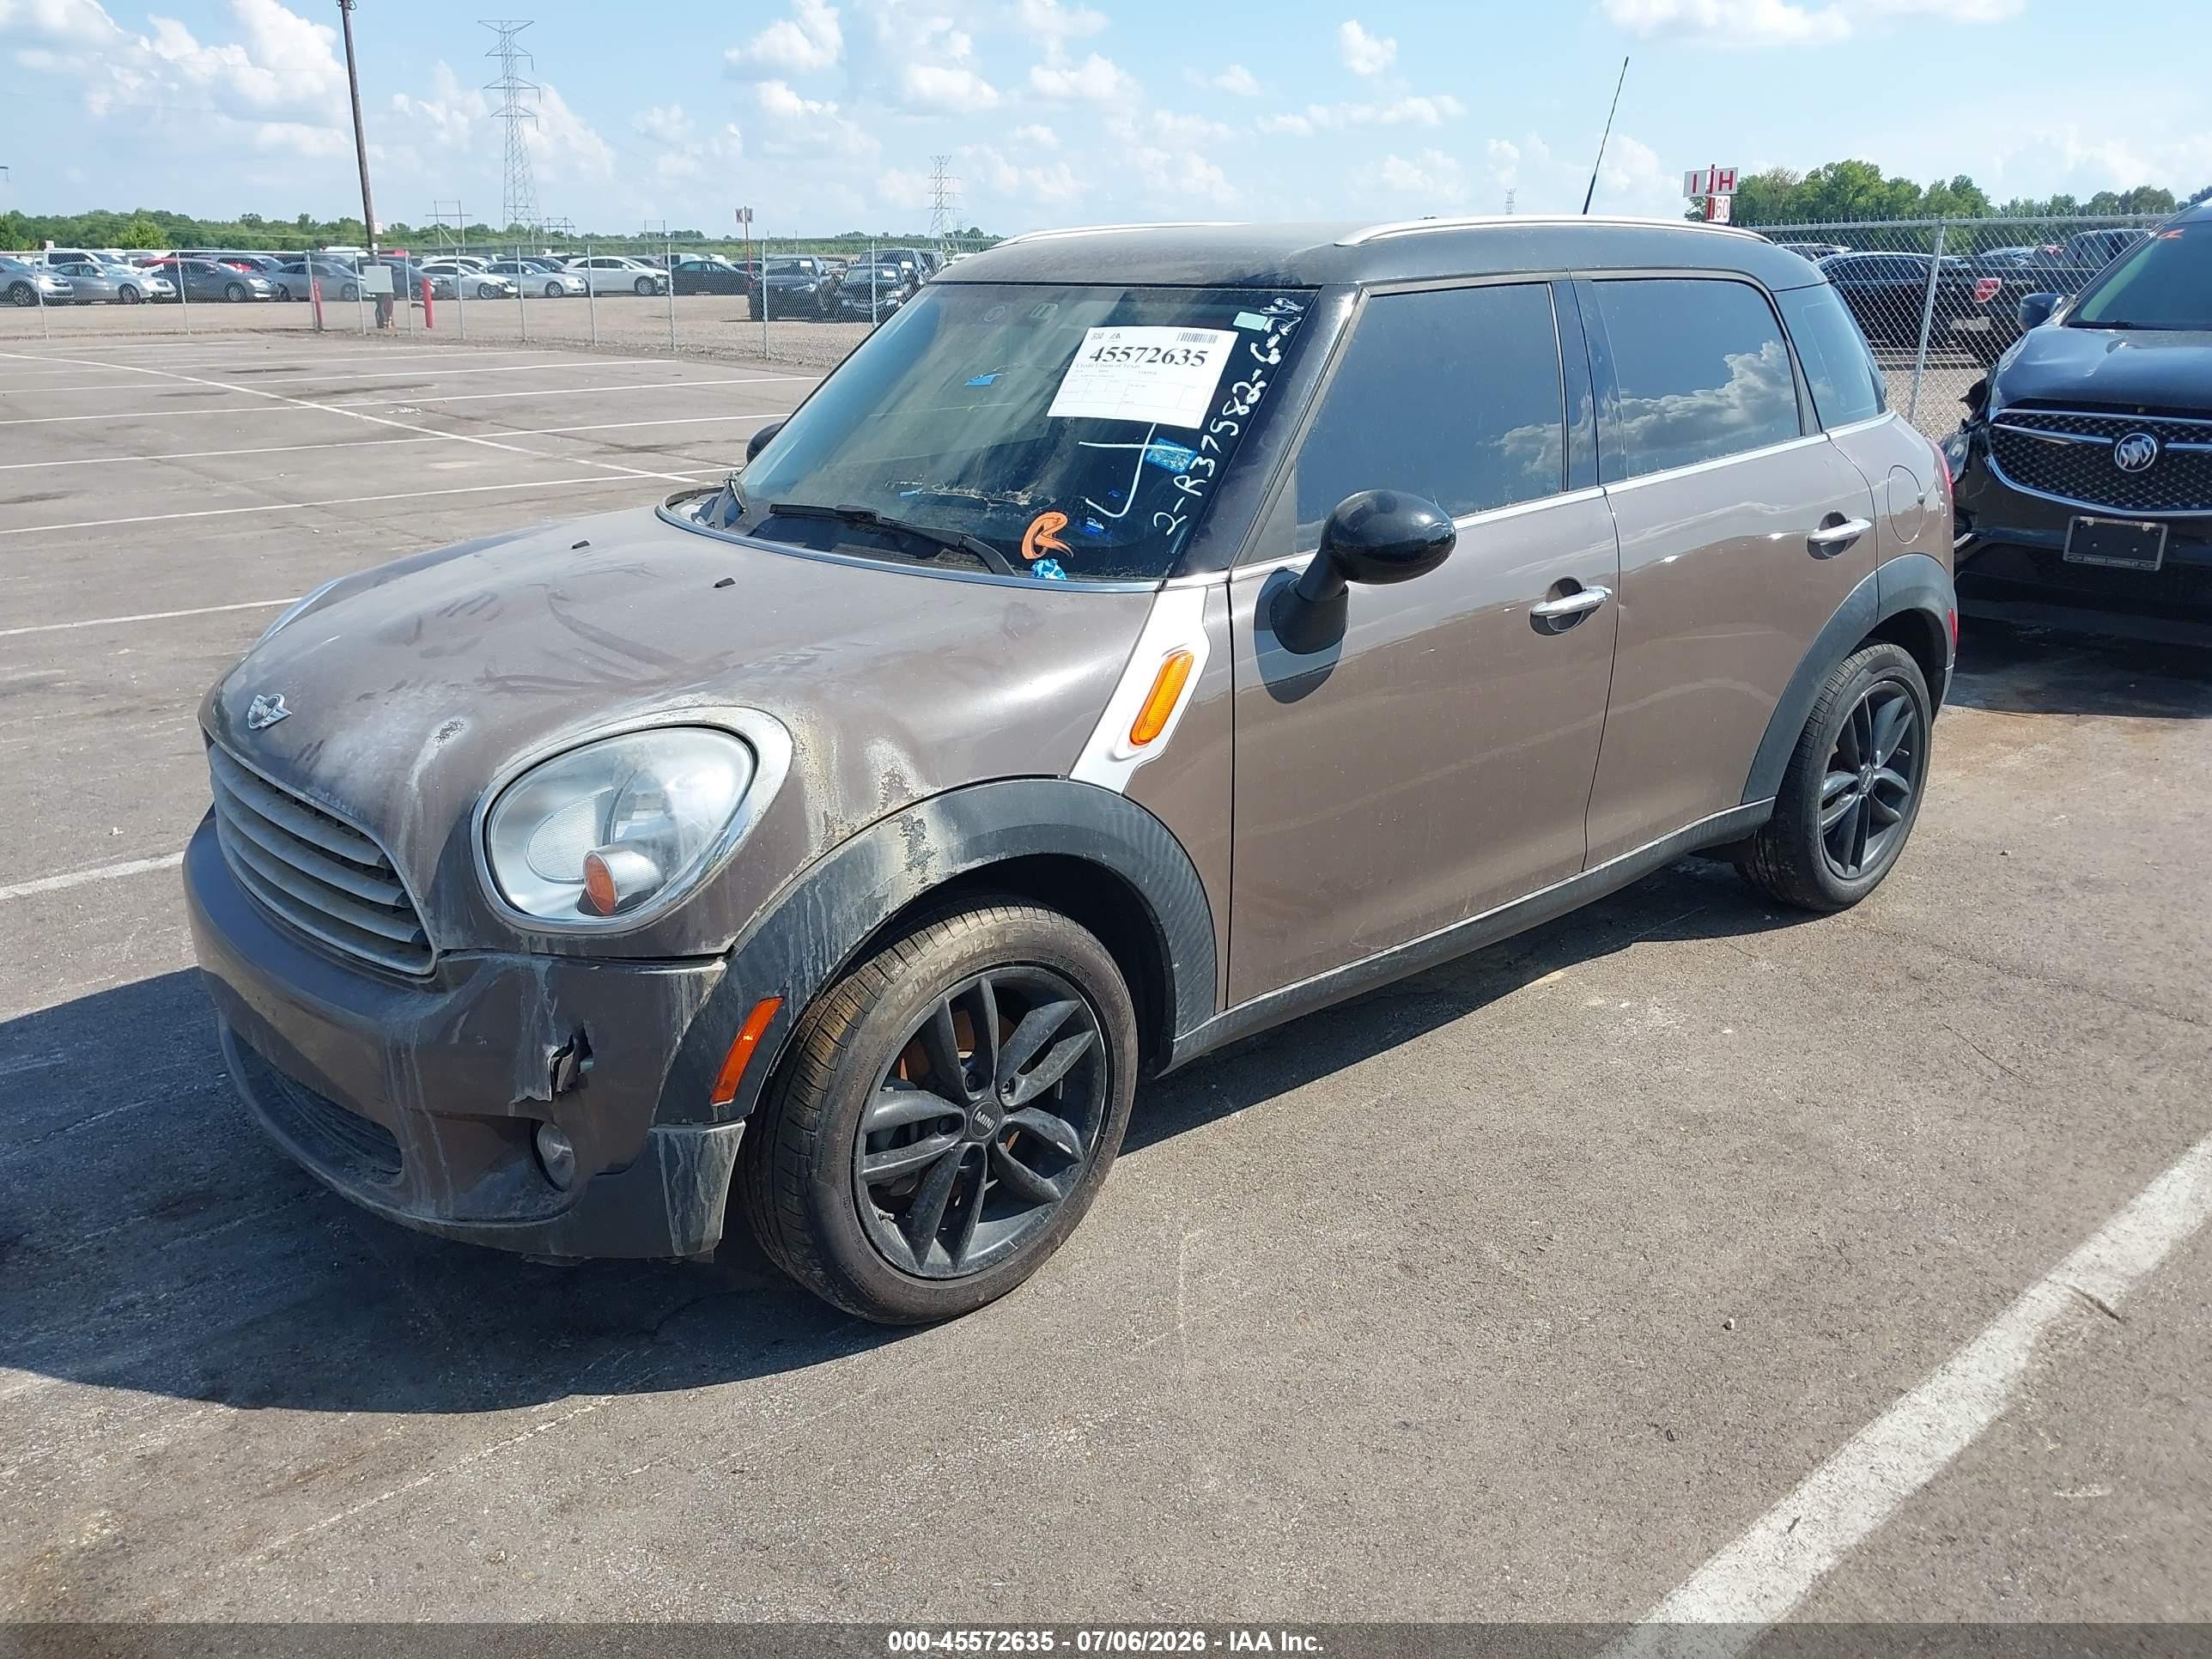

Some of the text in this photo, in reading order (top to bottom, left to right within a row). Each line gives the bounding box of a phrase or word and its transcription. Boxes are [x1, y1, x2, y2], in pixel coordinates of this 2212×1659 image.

[1718, 170, 1735, 191] H
[736, 209, 744, 222] K
[747, 209, 753, 222] J
[1715, 198, 1729, 218] 60
[1089, 346, 1209, 368] 45572635
[974, 1110, 996, 1130] MINI
